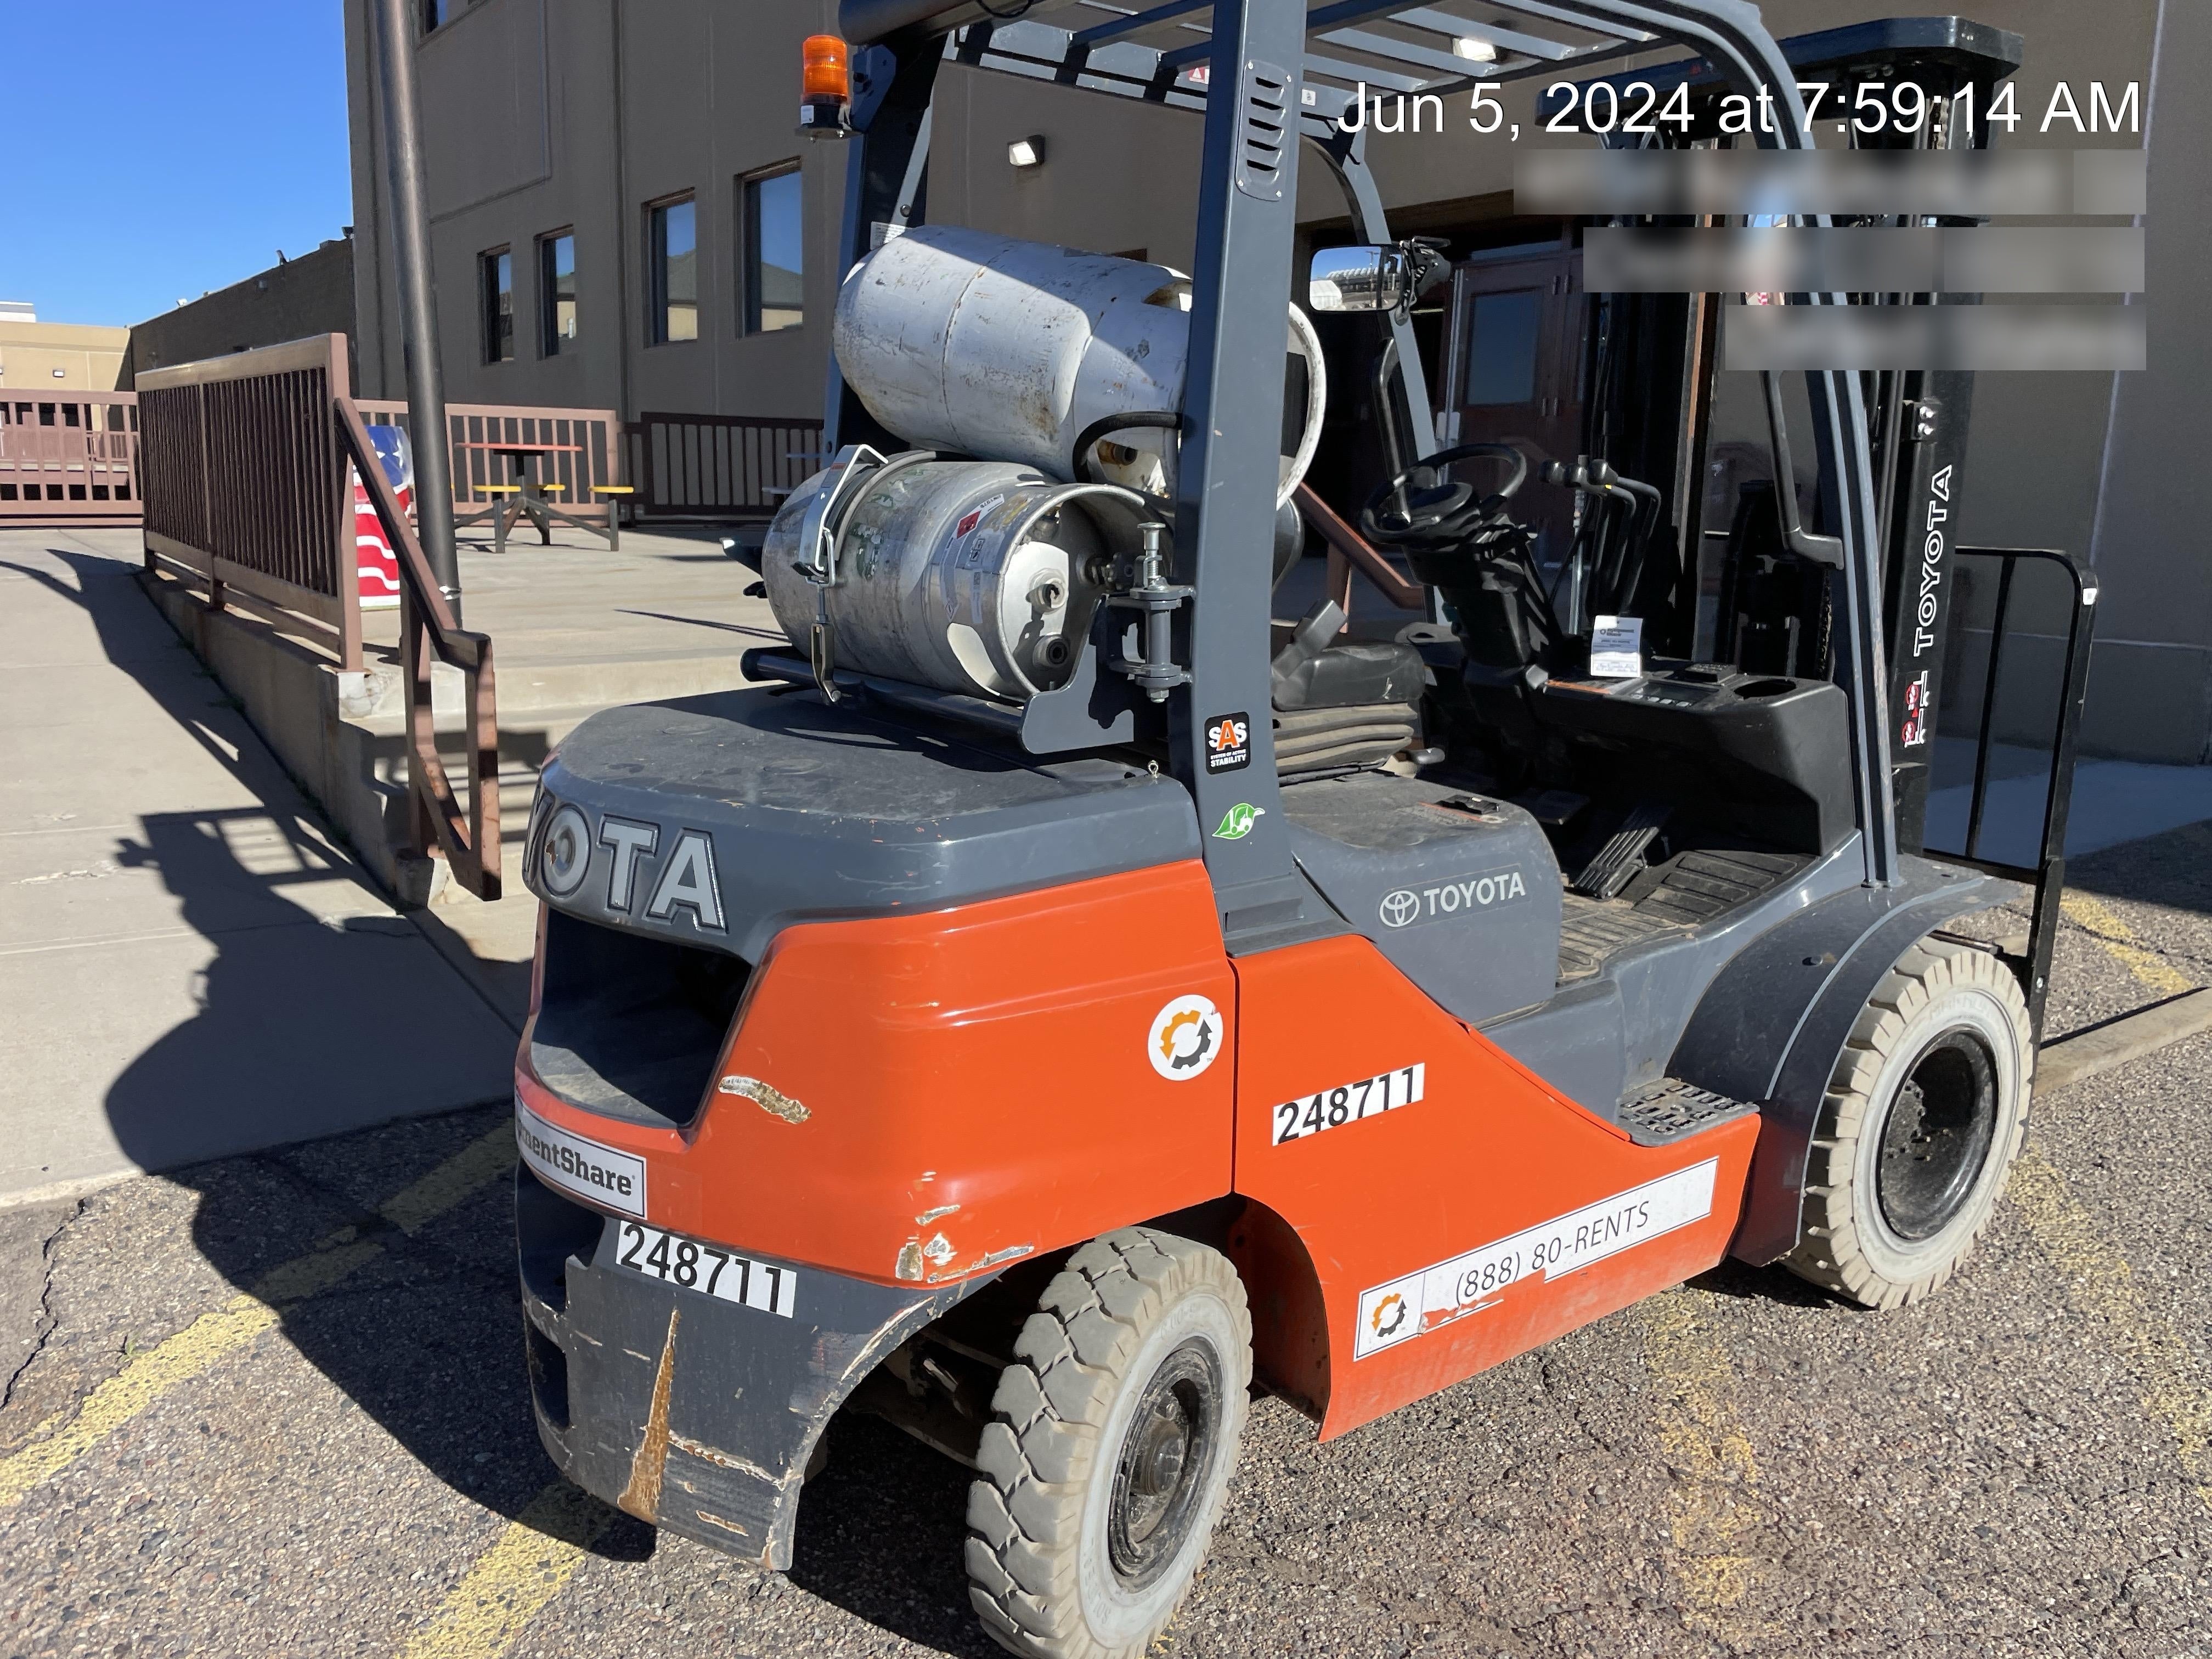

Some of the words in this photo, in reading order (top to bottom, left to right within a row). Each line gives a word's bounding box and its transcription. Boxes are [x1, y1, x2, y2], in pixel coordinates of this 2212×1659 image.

[1913, 464, 1952, 657] TOYOTA
[1209, 719, 1247, 751] SAS
[1210, 755, 1246, 768] STABILITY
[1423, 871, 1526, 916] TOYOTA
[1277, 1066, 1414, 1144] 248711
[620, 1223, 782, 1313] 248711
[1455, 1251, 1521, 1305] (888)
[1531, 1200, 1650, 1271] 80-RENTS
